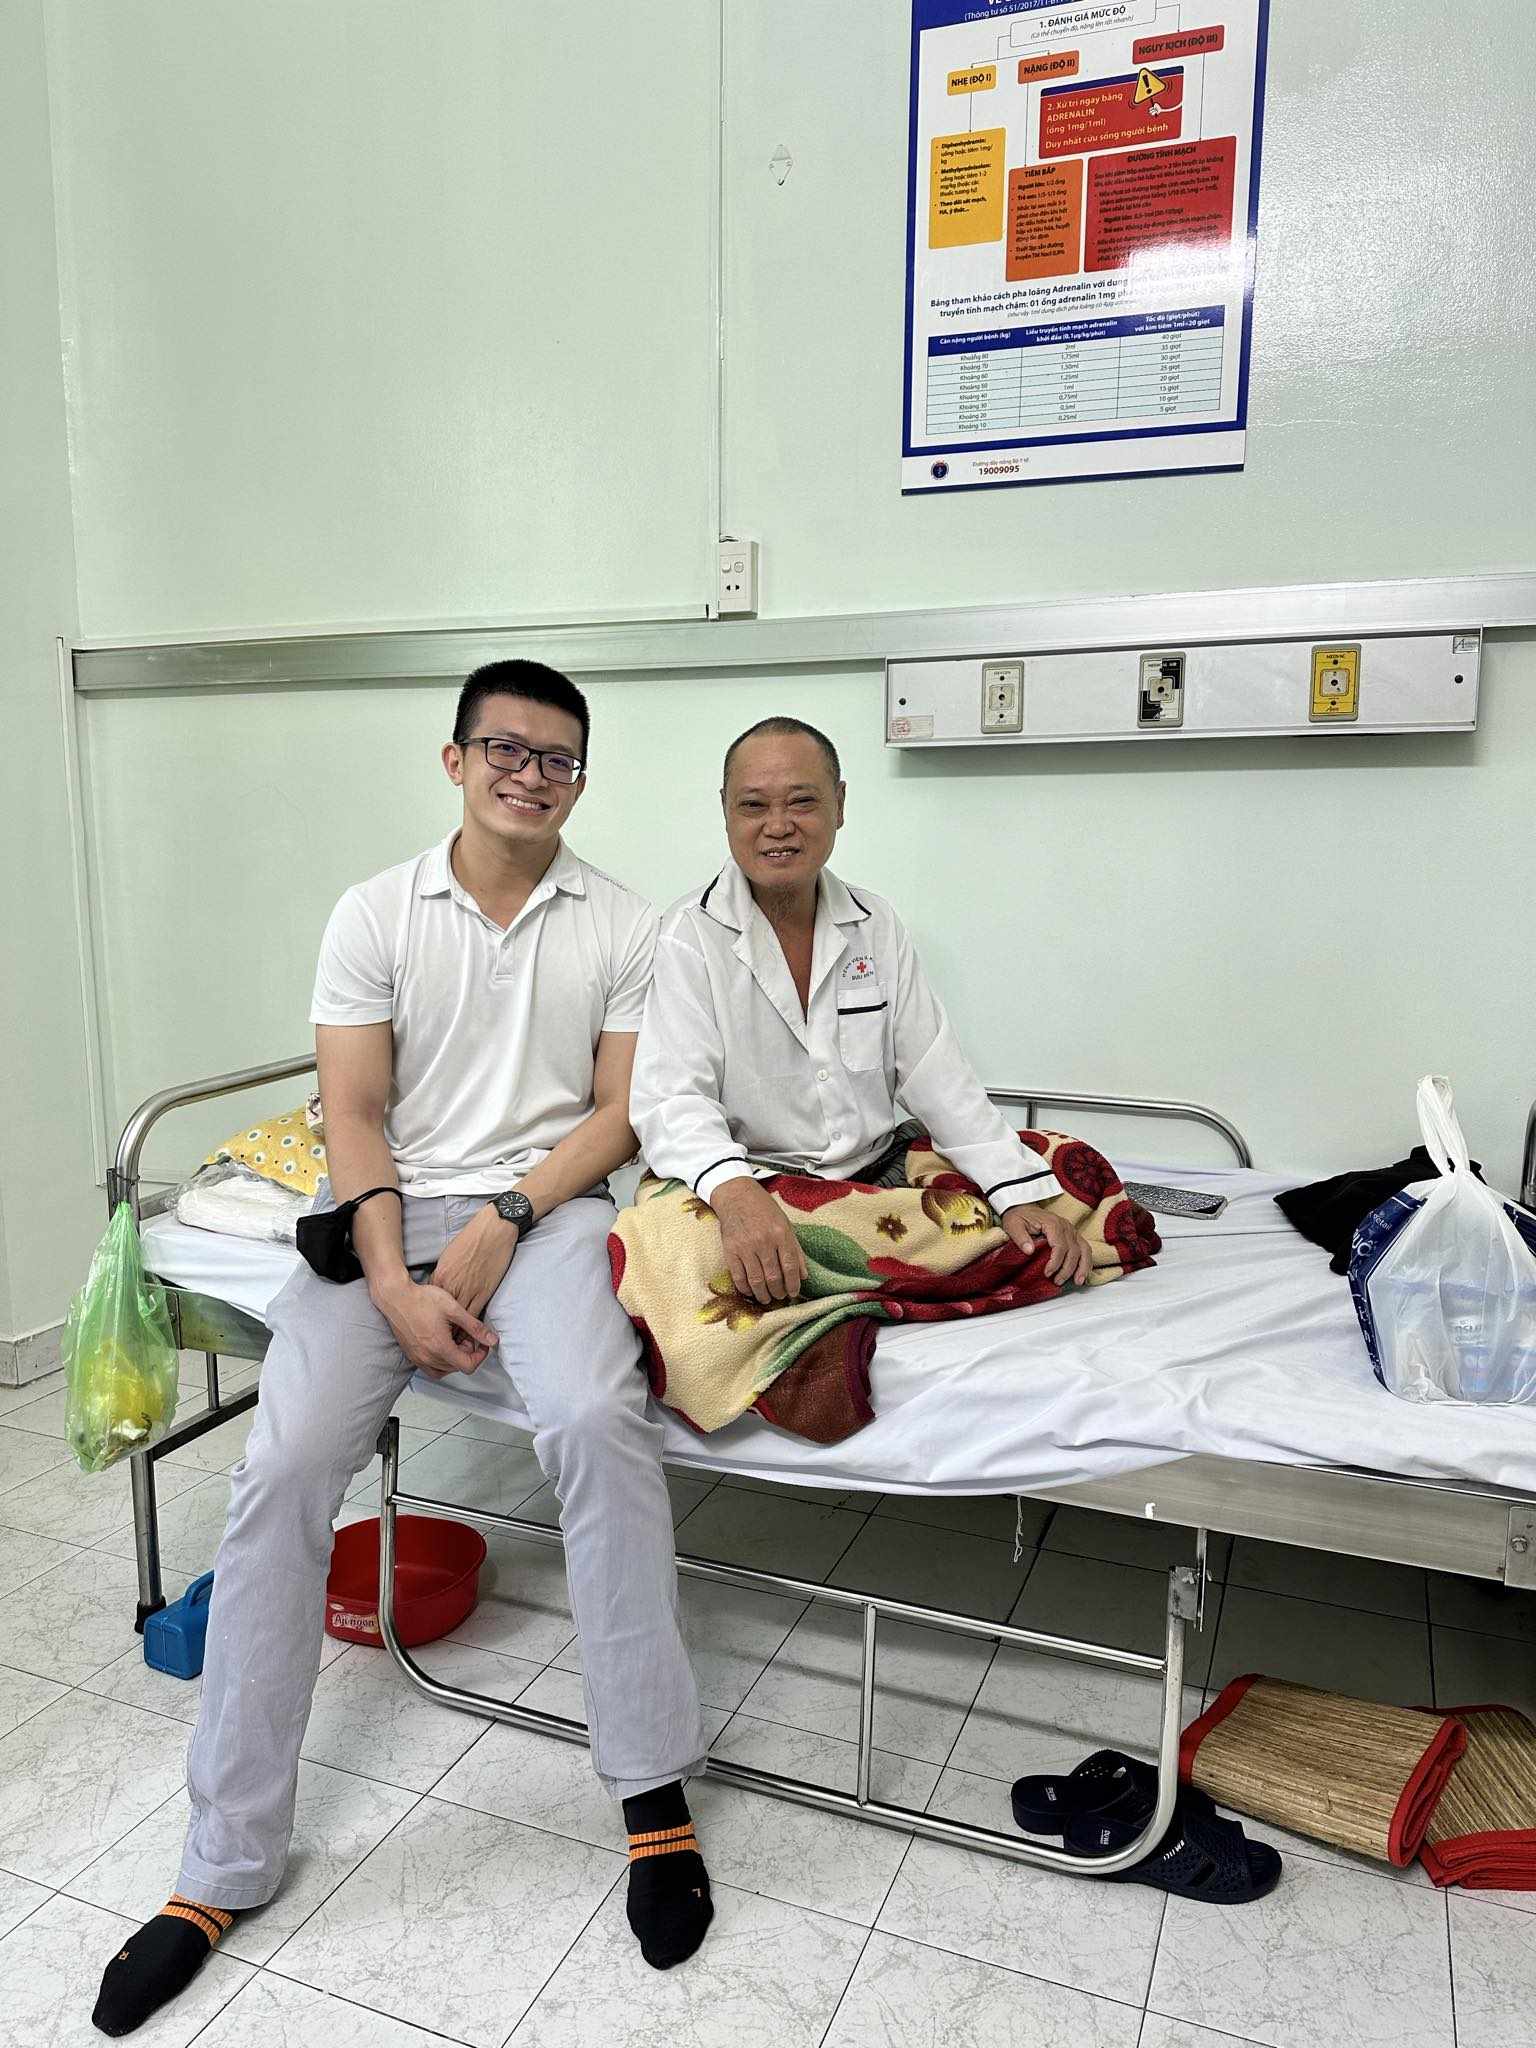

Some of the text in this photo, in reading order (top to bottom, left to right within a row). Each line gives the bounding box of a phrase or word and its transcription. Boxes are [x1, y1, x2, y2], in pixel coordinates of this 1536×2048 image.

[1047, 15, 1072, 27] ĐÁNH
[1074, 11, 1089, 22] GIÁ
[1091, 8, 1111, 19] MỨC
[1112, 4, 1126, 16] ĐỘ
[1024, 58, 1075, 75] NẶNG (ĐỘ II)
[952, 77, 968, 87] NHẸ
[969, 72, 985, 85] (ĐỘ
[1080, 96, 1100, 106] ngay
[1047, 108, 1095, 123] ADRENALIN
[1046, 141, 1061, 149] Duy
[930, 299, 950, 308] Bảng
[952, 296, 971, 305] tham
[973, 293, 992, 302] khảo
[993, 290, 1010, 300] cách
[1012, 289, 1027, 300] pha
[1028, 287, 1050, 296] loãng
[1052, 282, 1091, 293] Adrenalin
[1093, 280, 1105, 288] với
[940, 307, 965, 318] truyền
[966, 305, 982, 314] tĩnh
[983, 303, 1004, 314] mạch
[1006, 301, 1029, 311] chậm:
[1030, 299, 1039, 307] 01
[1041, 297, 1057, 307] ống
[1058, 293, 1096, 304] adrenalin
[1098, 292, 1116, 300] 1mg
[979, 465, 1020, 476] 19009095
